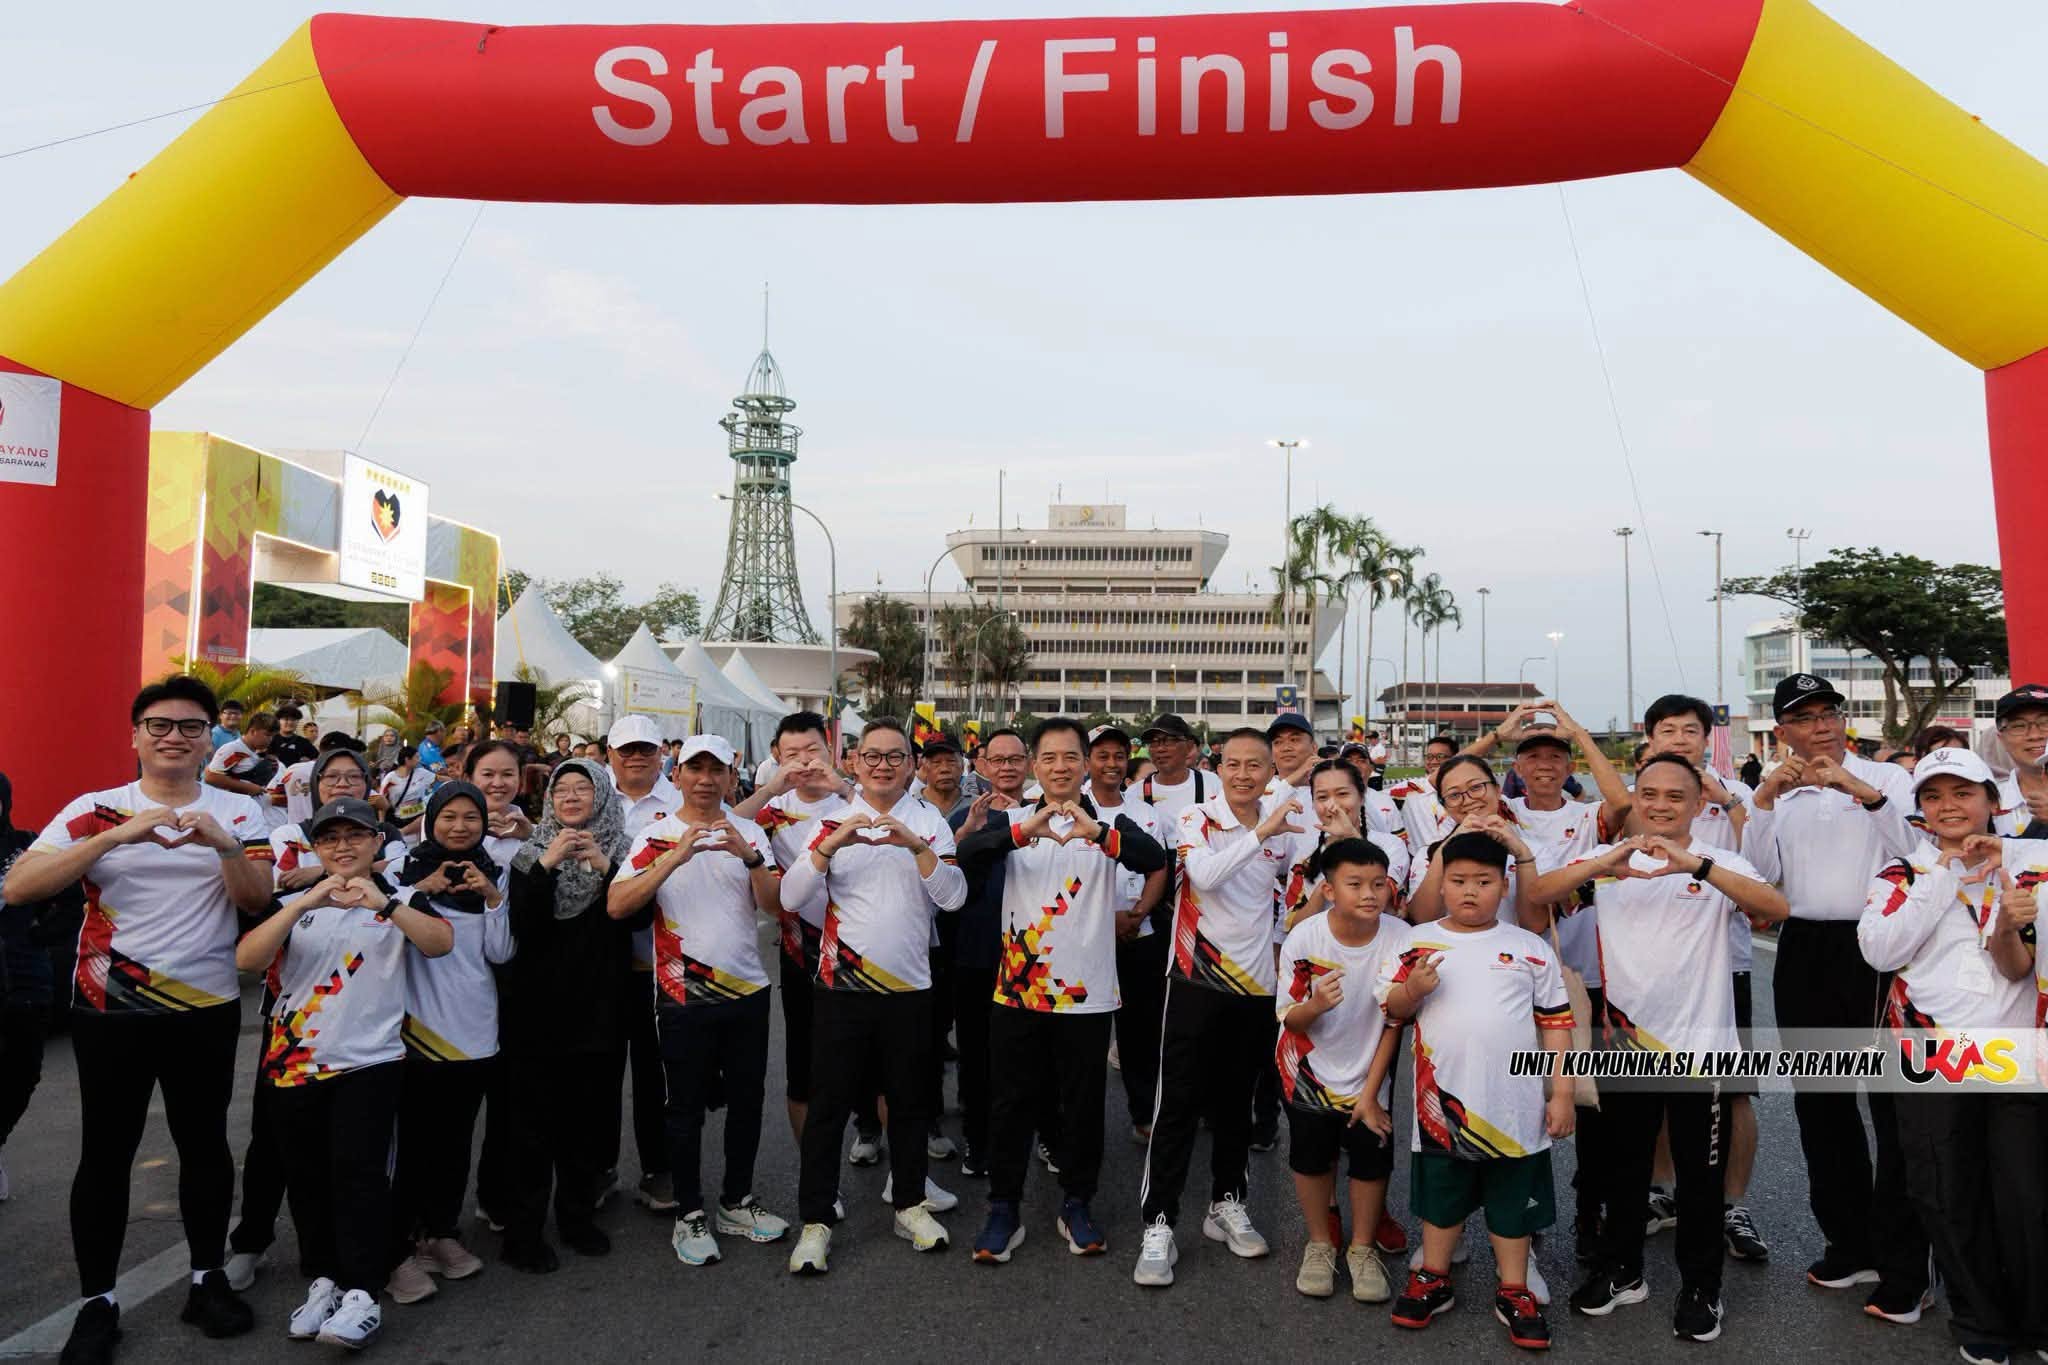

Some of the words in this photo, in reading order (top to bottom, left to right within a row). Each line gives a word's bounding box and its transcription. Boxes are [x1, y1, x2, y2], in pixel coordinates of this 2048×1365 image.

[592, 45, 918, 146] Start
[955, 40, 998, 144] /
[1044, 26, 1462, 139] Finish
